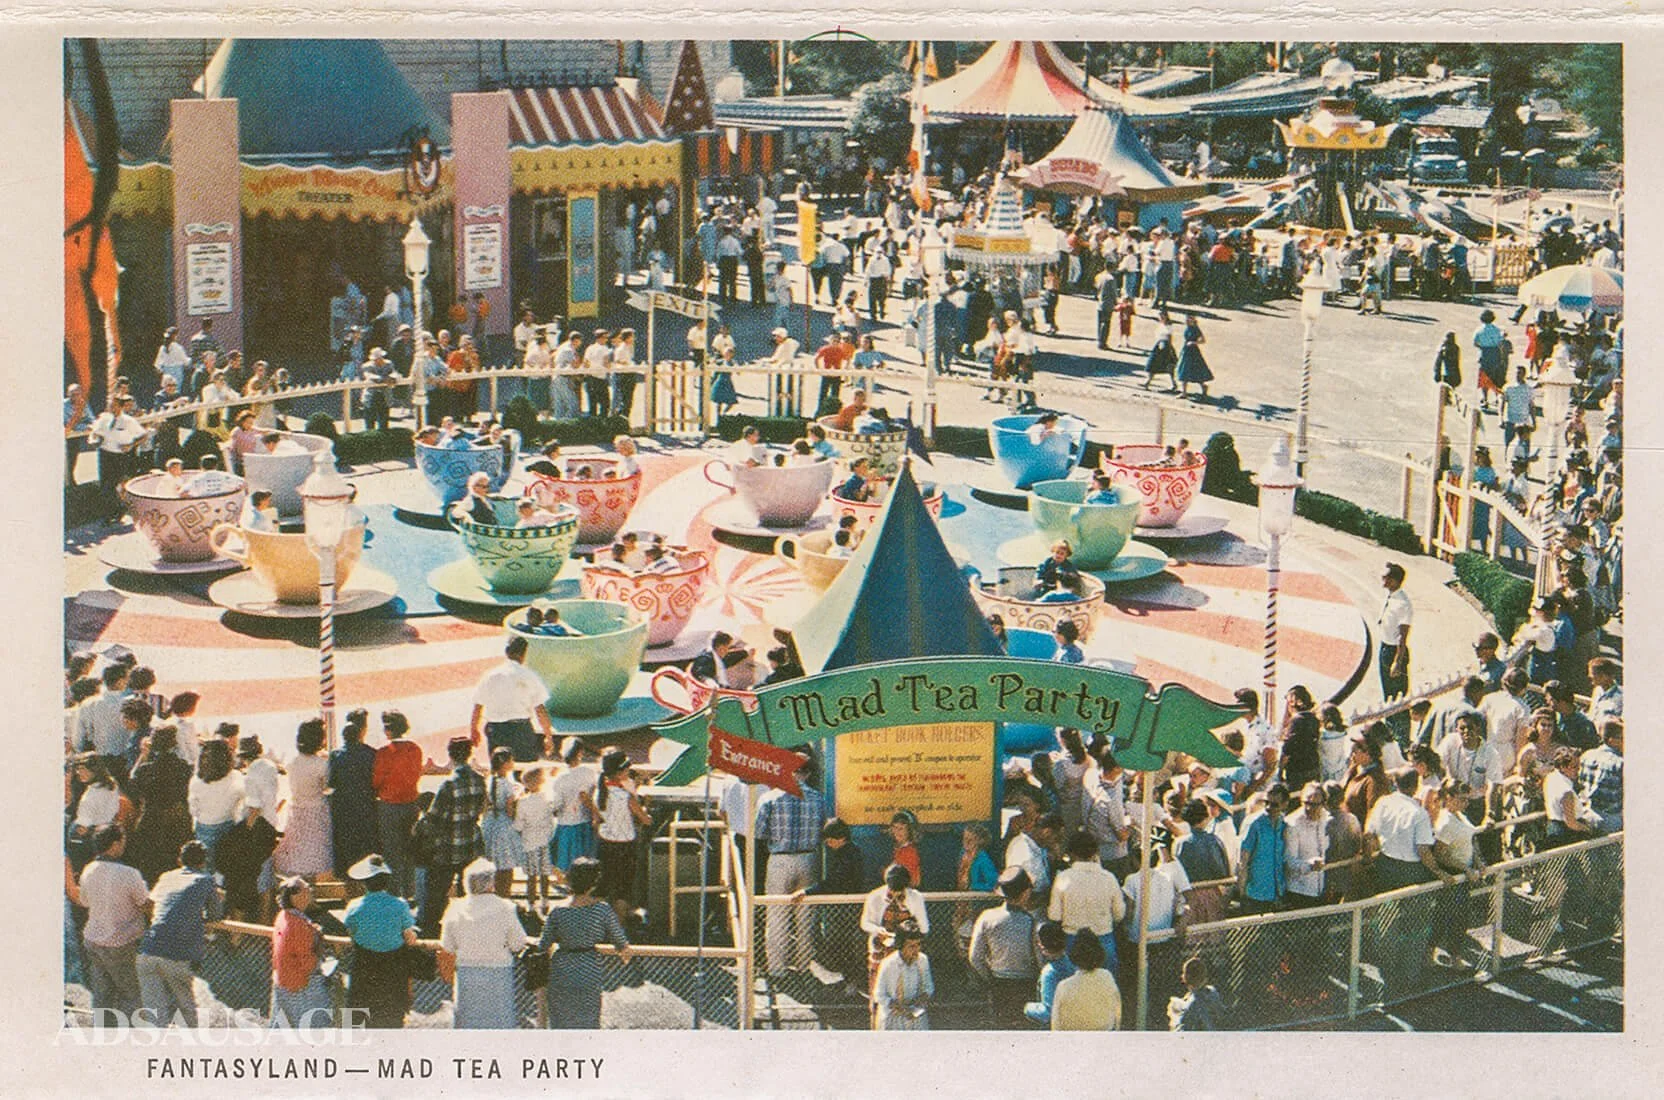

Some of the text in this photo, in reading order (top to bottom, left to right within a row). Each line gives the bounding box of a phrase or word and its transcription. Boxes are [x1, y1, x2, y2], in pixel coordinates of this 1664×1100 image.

[653, 293, 705, 318] EXIT
[778, 672, 1122, 734] Mad Tea Party
[719, 738, 782, 776] Entrance
[453, 1058, 503, 1078] TEA
[522, 1058, 605, 1078] PARTY
